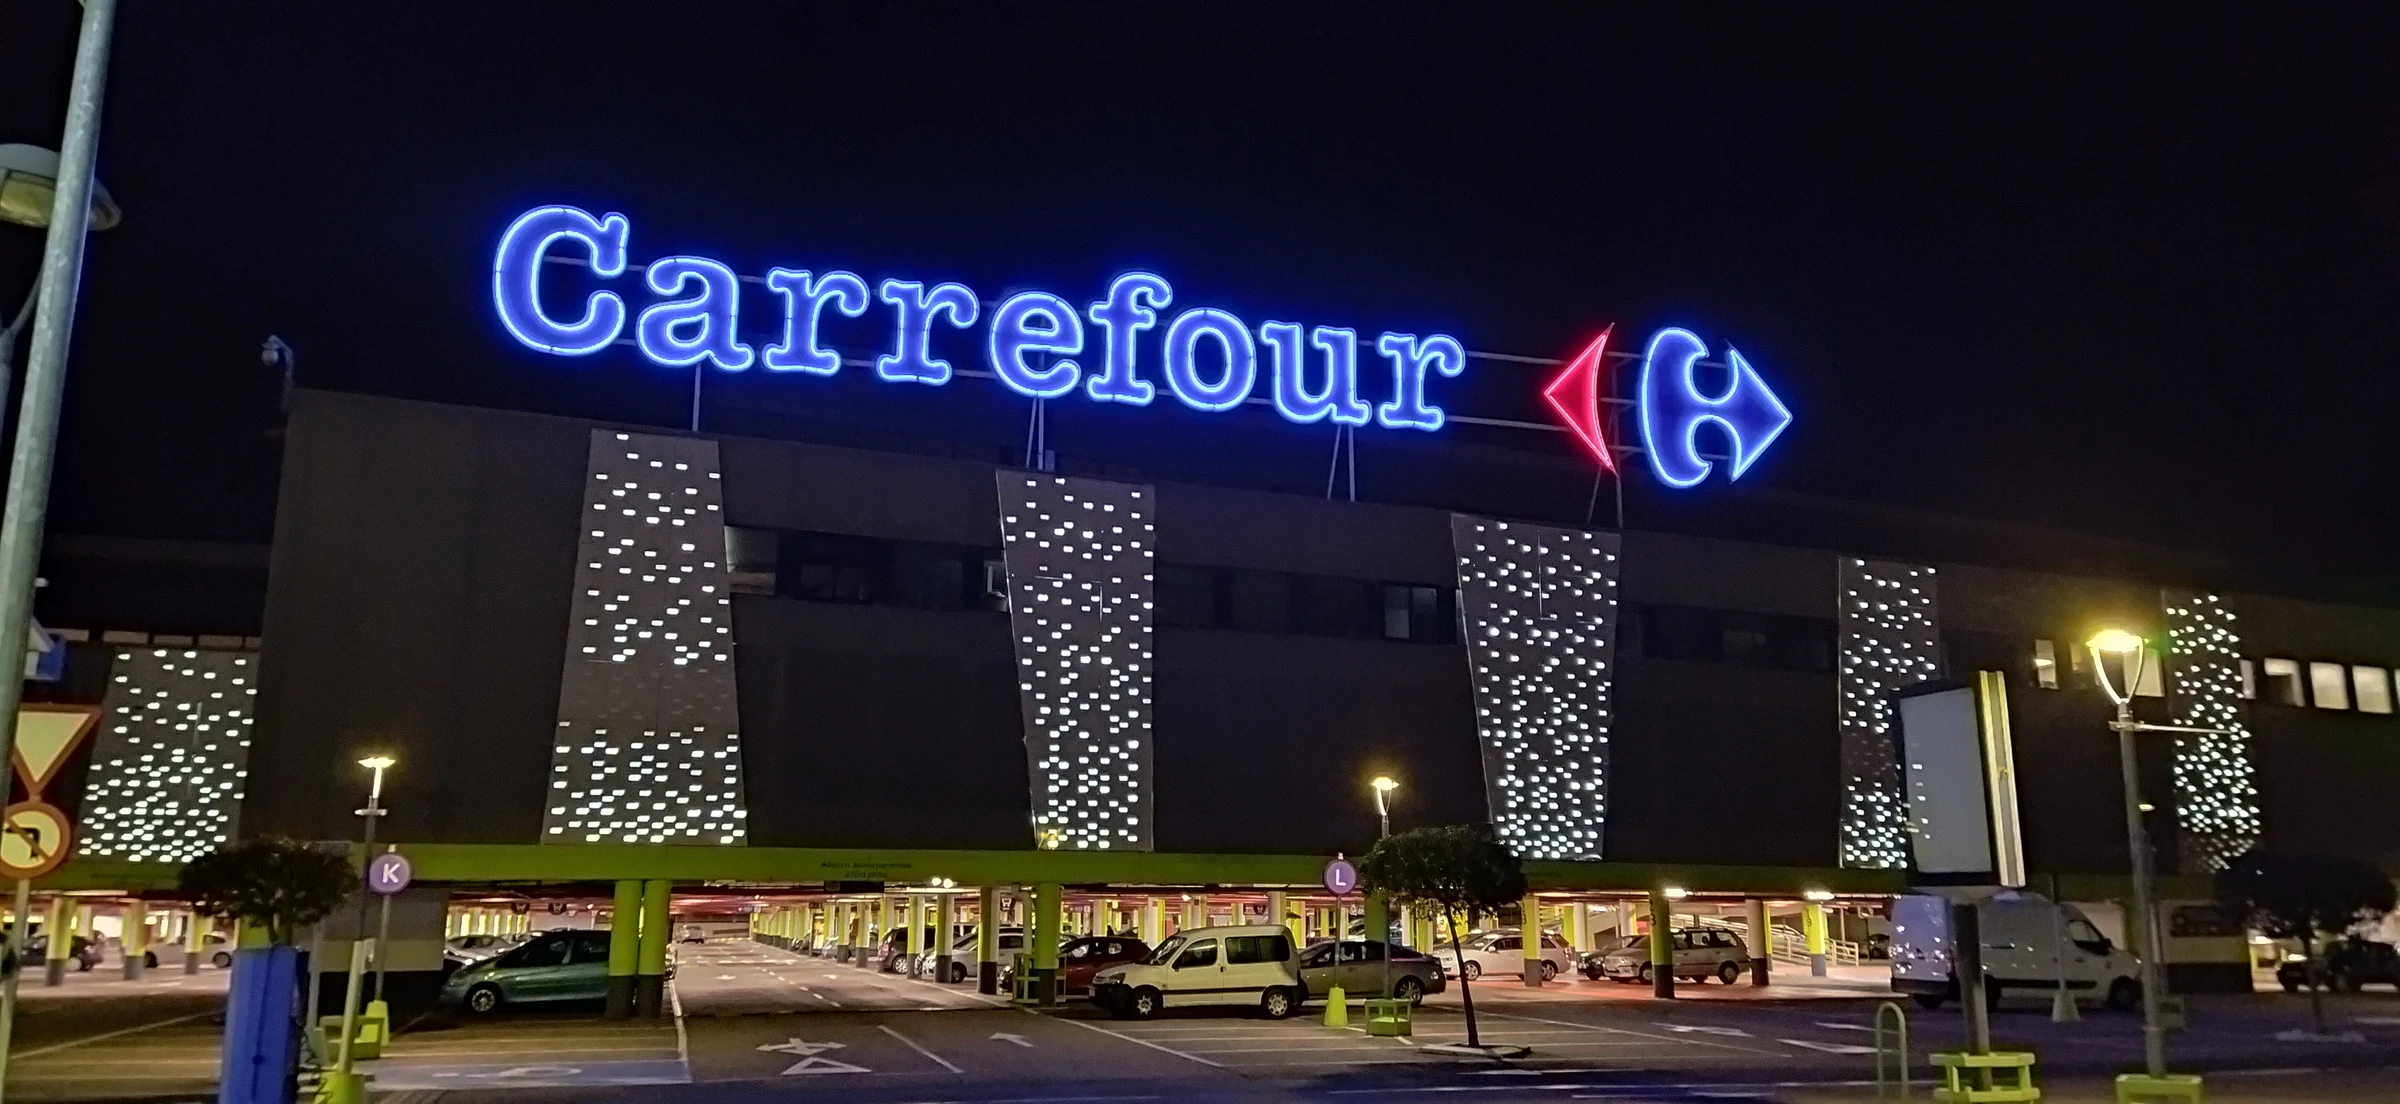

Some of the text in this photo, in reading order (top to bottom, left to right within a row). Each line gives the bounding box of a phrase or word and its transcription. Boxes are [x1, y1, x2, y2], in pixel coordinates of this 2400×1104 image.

[491, 204, 1467, 430] Carrefour
[382, 863, 400, 883] K
[1335, 868, 1347, 887] L
